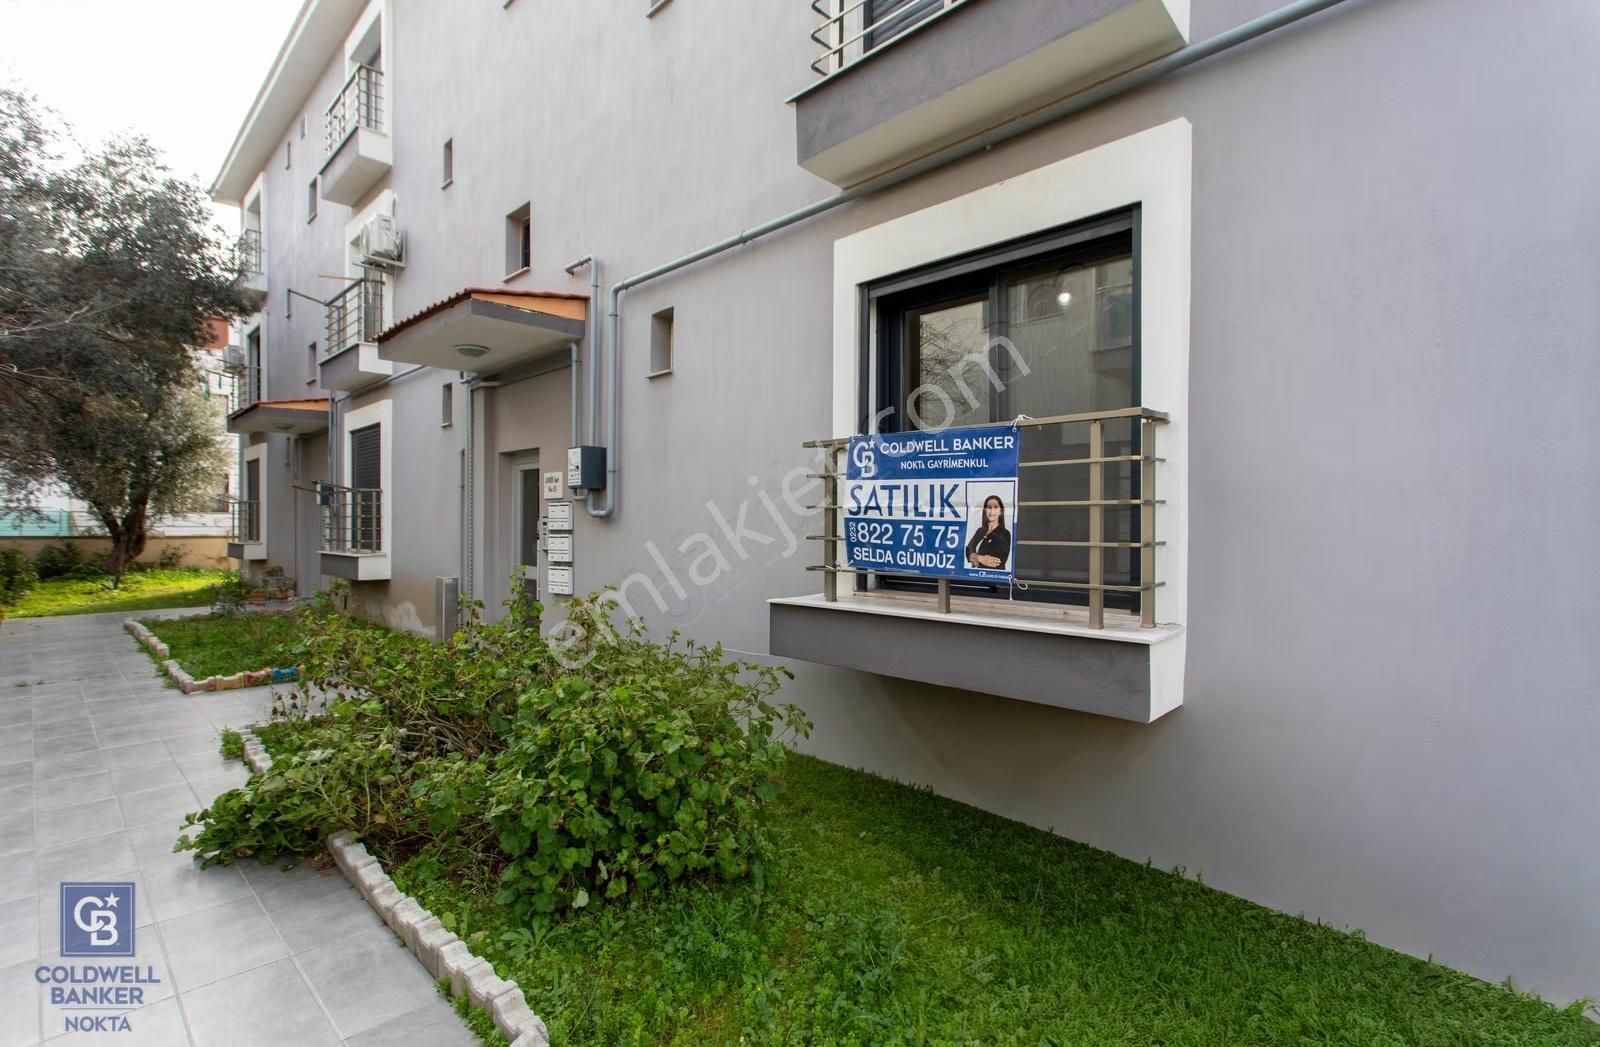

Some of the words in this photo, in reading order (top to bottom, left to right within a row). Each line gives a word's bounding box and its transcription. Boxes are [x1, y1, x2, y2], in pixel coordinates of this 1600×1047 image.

[880, 439, 949, 454] COLDWELL
[953, 436, 1014, 451] BANKER
[900, 460, 926, 470] NOKTA
[927, 457, 989, 469] GAYRİMENKUL
[848, 483, 961, 518] SATILIK
[857, 522, 894, 545] 822
[900, 524, 924, 547] 75
[931, 525, 959, 549] 75
[853, 547, 894, 564] SELDA
[896, 549, 956, 569] GÜNDÜZ
